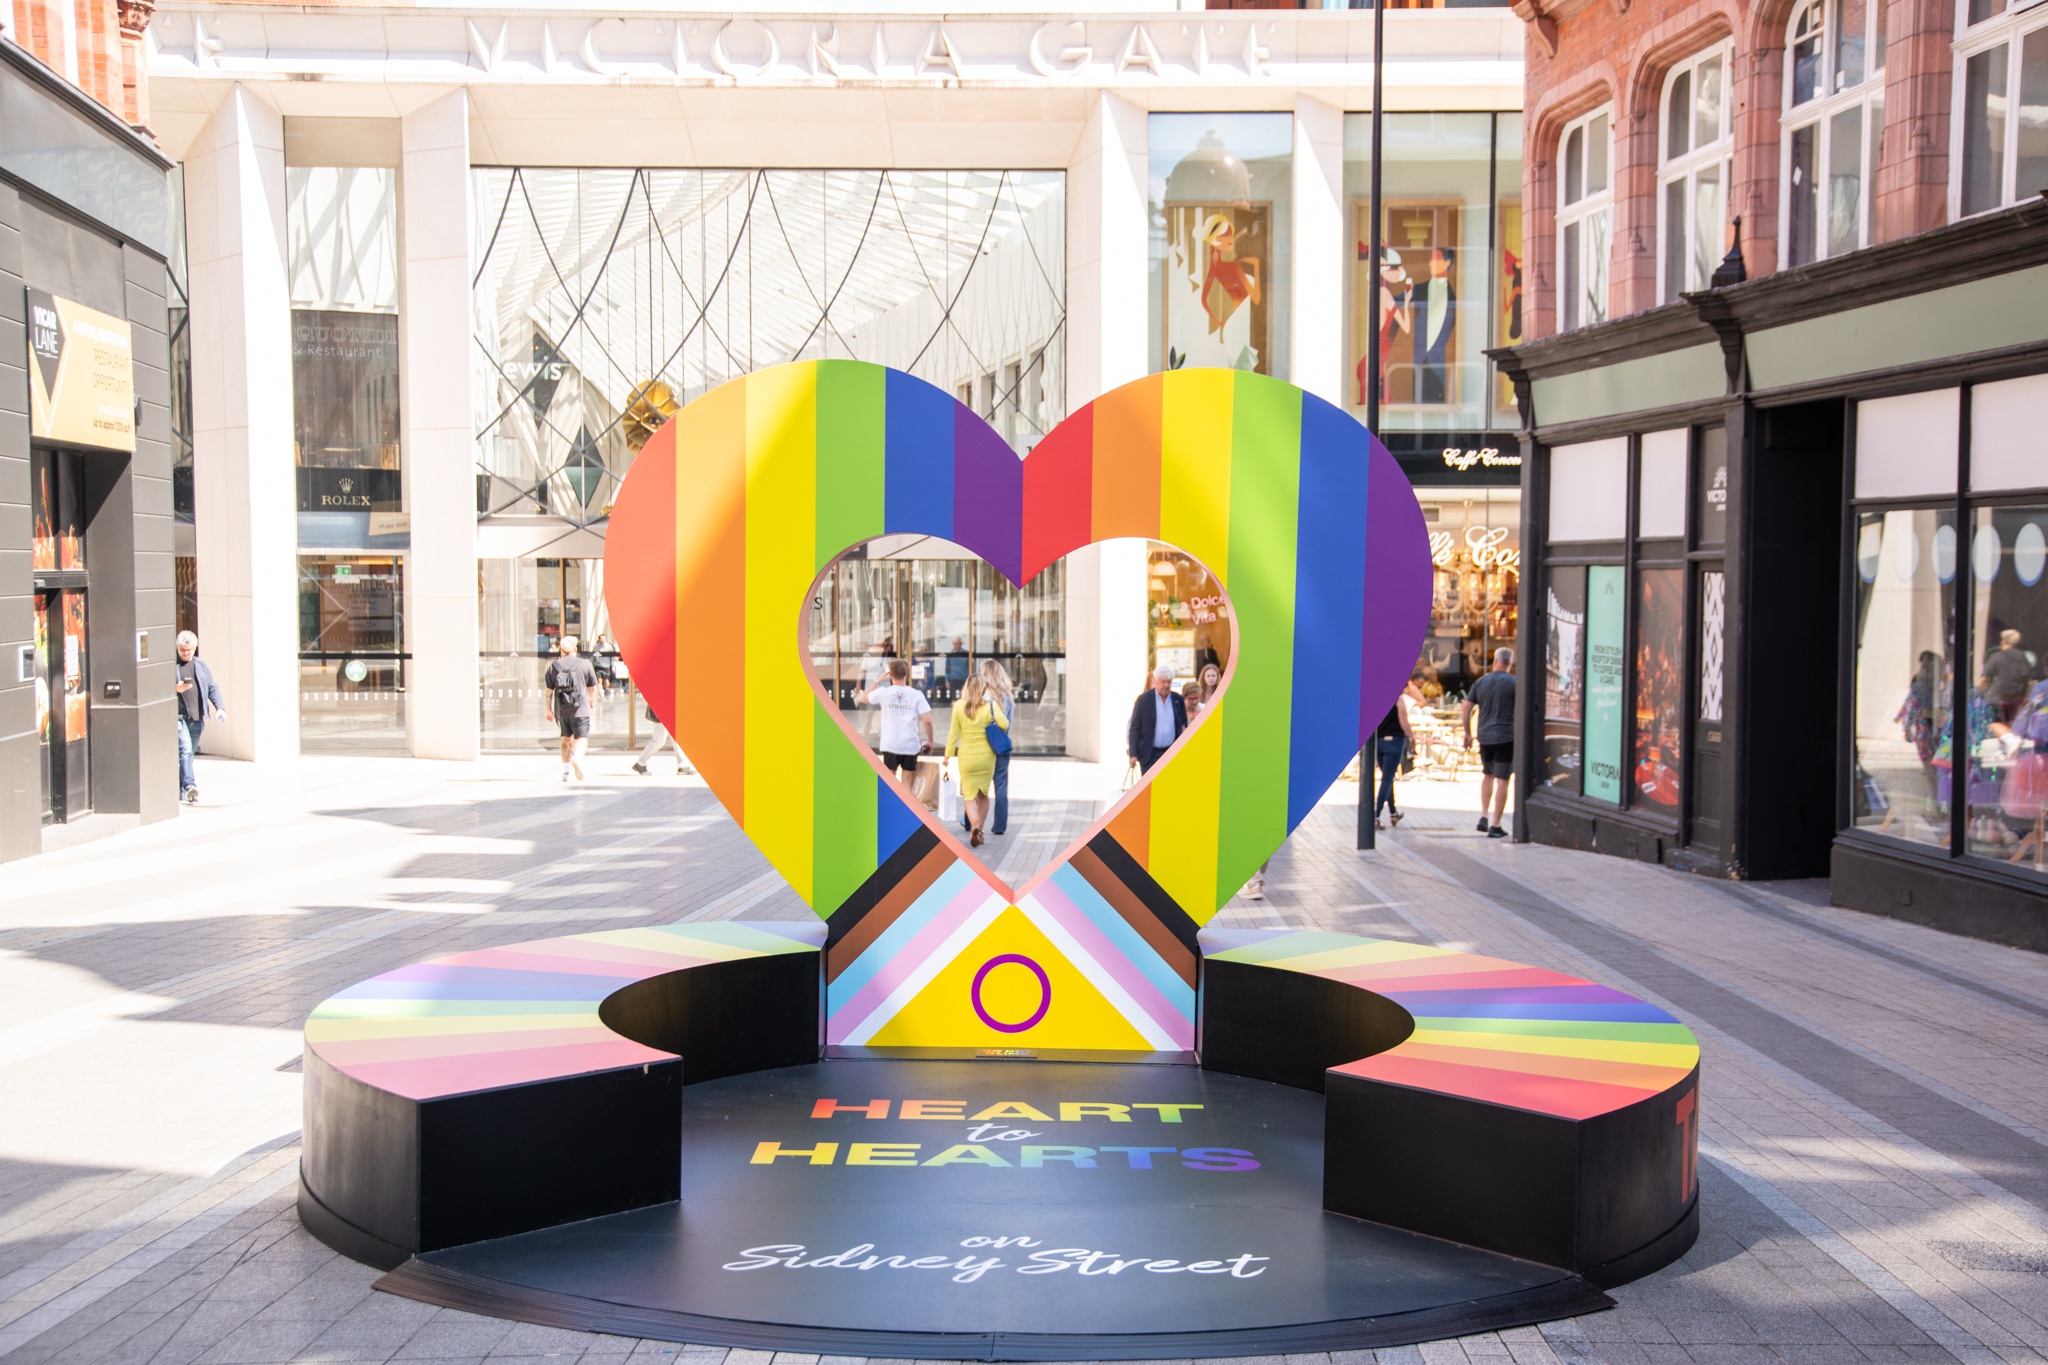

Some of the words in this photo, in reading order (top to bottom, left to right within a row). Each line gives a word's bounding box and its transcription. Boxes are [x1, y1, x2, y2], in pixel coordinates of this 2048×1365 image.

[466, 16, 961, 78] VICTORIA
[1028, 20, 1275, 79] GATE
[33, 305, 57, 330] VICAR
[35, 326, 59, 354] LANE
[296, 325, 398, 345] QUOTIDI
[94, 348, 129, 373] RESTAURANT
[308, 343, 382, 358] Restaurant
[500, 355, 562, 381] ewis
[93, 372, 129, 394] OPPORTUNITY
[321, 495, 371, 506] ROLEX
[1706, 489, 1727, 503] VICTO
[1191, 594, 1225, 609] Dolce
[1191, 612, 1217, 625] Vita
[809, 1098, 1205, 1123] HEART
[966, 1122, 1044, 1142] to
[749, 1141, 1262, 1172] HEARTS
[960, 1235, 1043, 1249] on
[721, 1243, 1008, 1283] Sidney
[1016, 1248, 1271, 1280] Street
